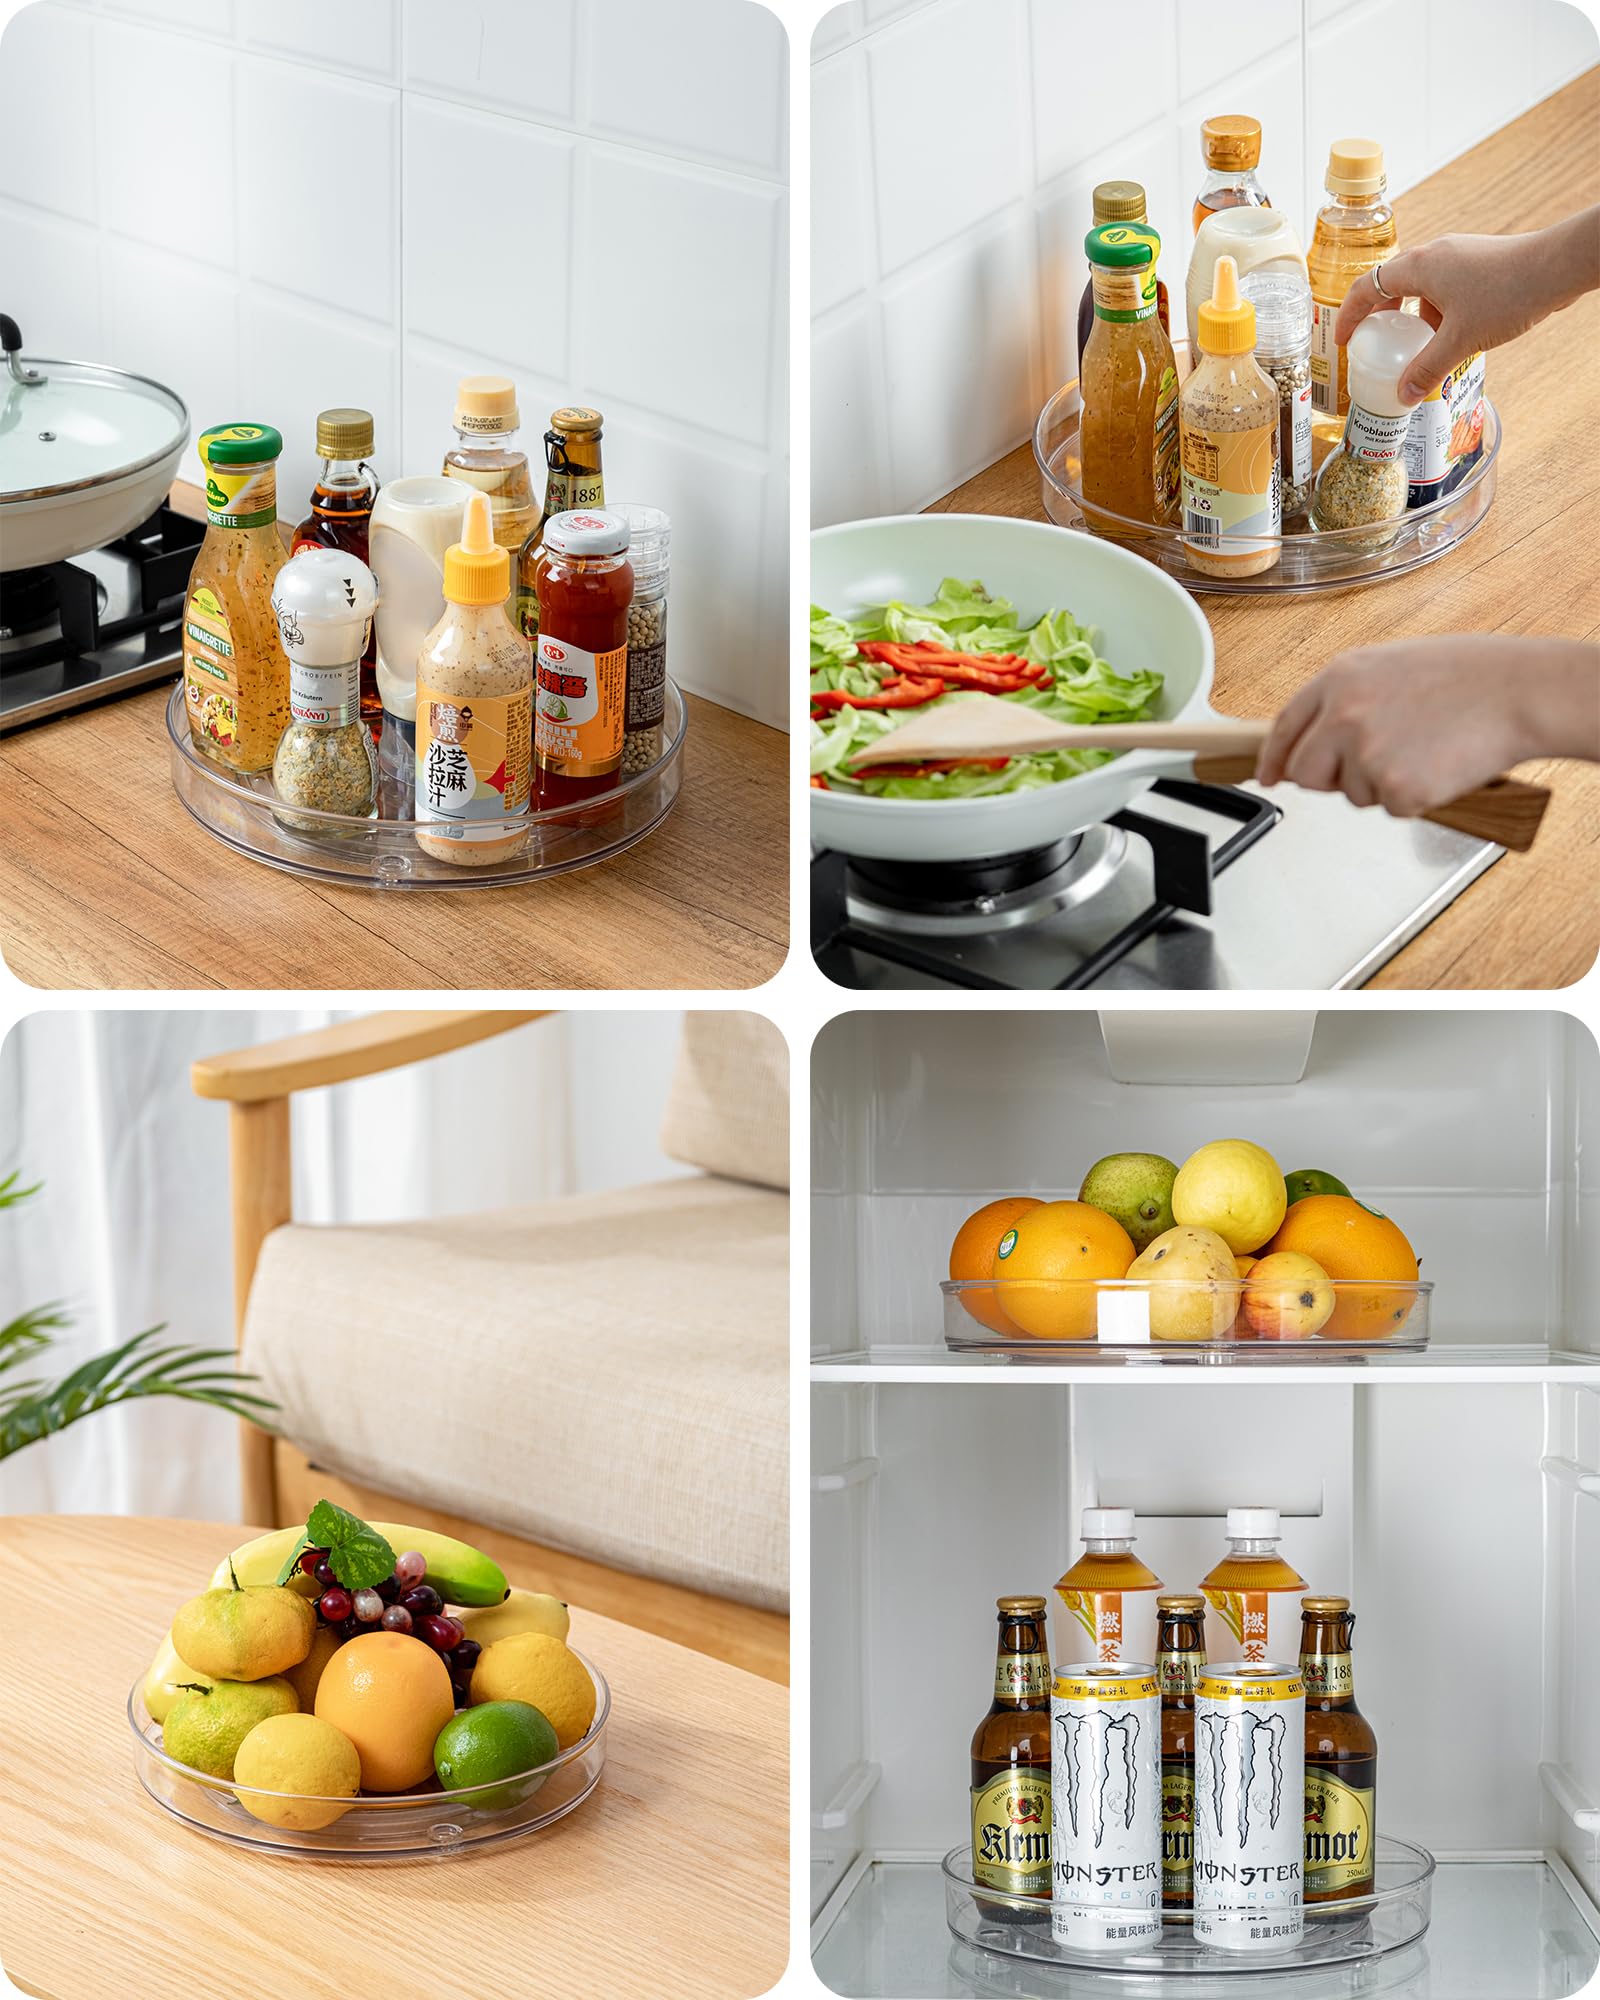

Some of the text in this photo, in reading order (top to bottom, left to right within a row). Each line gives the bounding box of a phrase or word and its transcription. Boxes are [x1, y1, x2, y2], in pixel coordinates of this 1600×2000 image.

[571, 485, 602, 503] 1887
[188, 622, 231, 657] VINAIGRETTE
[428, 742, 447, 808] 沙拉汁
[446, 748, 468, 792] 芝麻
[993, 1785, 1019, 1806] PREMIUM
[1021, 1785, 1042, 1794] LAGER
[1170, 1782, 1192, 1793] LAGER
[1325, 1789, 1341, 1805] BEER
[1195, 1859, 1300, 1887] MONSTER
[1059, 1887, 1145, 1901] ENRGY
